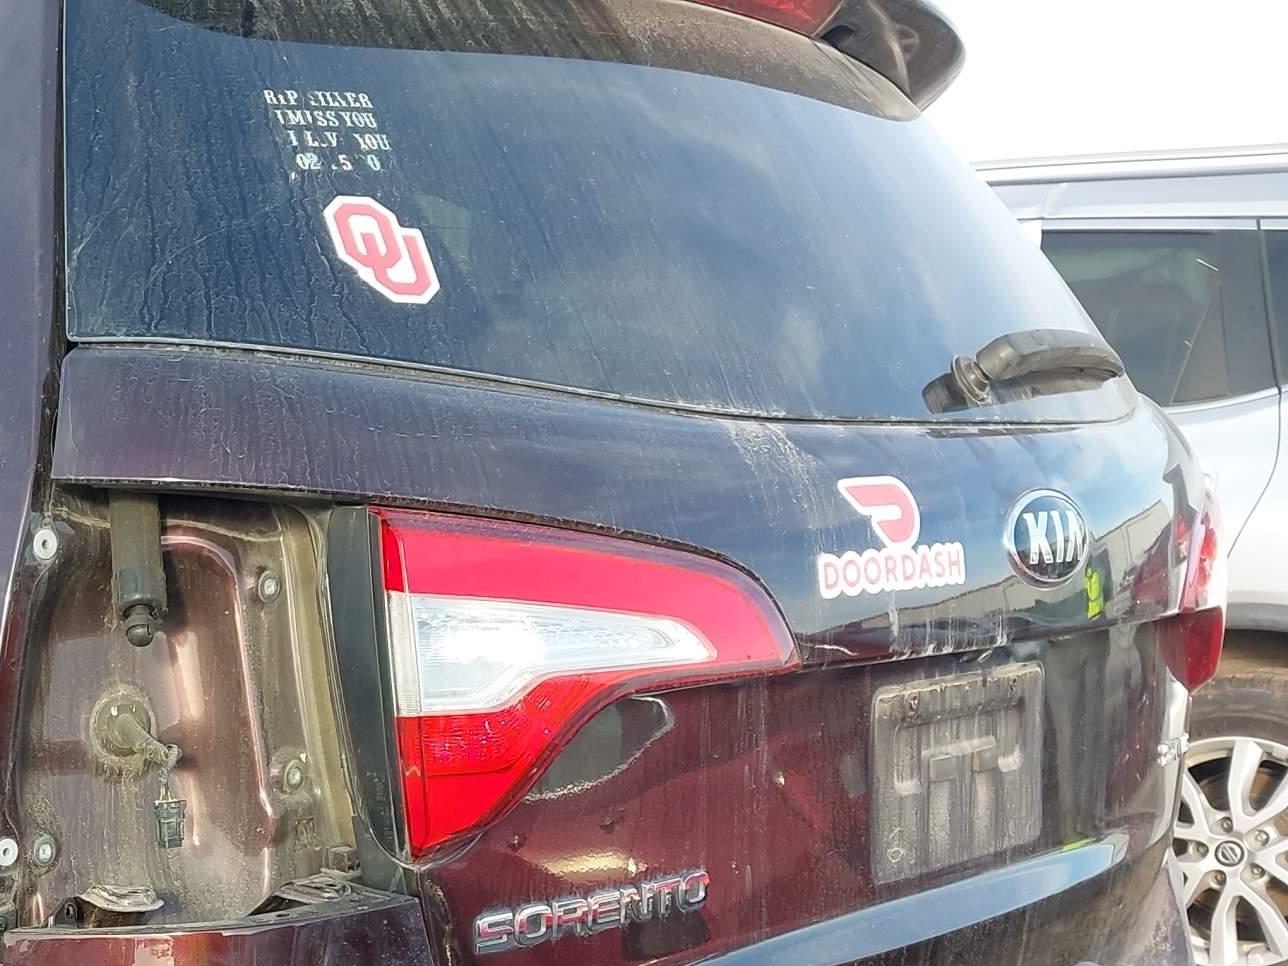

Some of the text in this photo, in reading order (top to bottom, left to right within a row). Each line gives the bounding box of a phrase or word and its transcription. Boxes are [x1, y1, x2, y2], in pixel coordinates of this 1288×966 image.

[339, 111, 378, 128] YOU
[1022, 510, 1088, 565] KIA
[823, 550, 962, 591] DOORDASH
[474, 870, 710, 955] SORENTO
